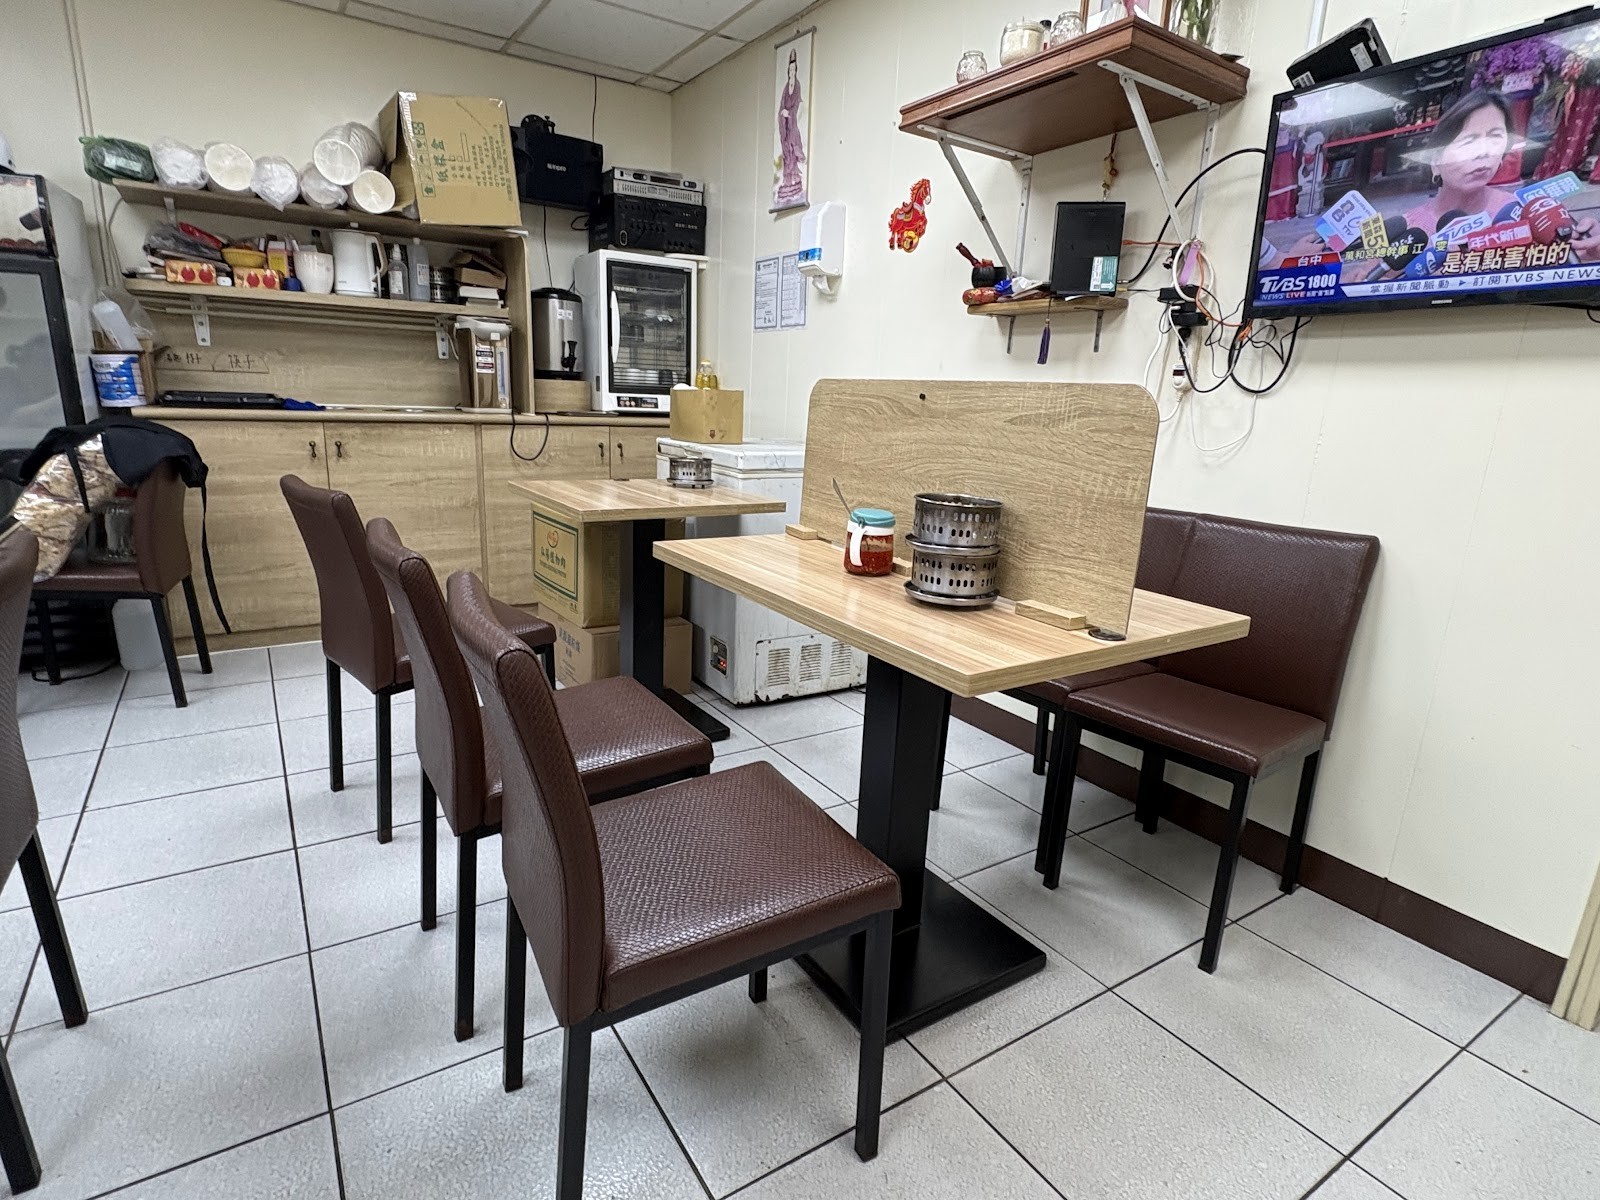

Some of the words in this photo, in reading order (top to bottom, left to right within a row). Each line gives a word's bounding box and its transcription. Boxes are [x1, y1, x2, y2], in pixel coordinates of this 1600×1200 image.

[1298, 255, 1322, 267] 台中
[1442, 241, 1571, 274] 是有點害怕的
[1260, 276, 1307, 293] TVBS
[1308, 274, 1336, 289] 1800
[1370, 279, 1450, 294] 掌握新聞脈動
[1286, 291, 1306, 299] LIVE
